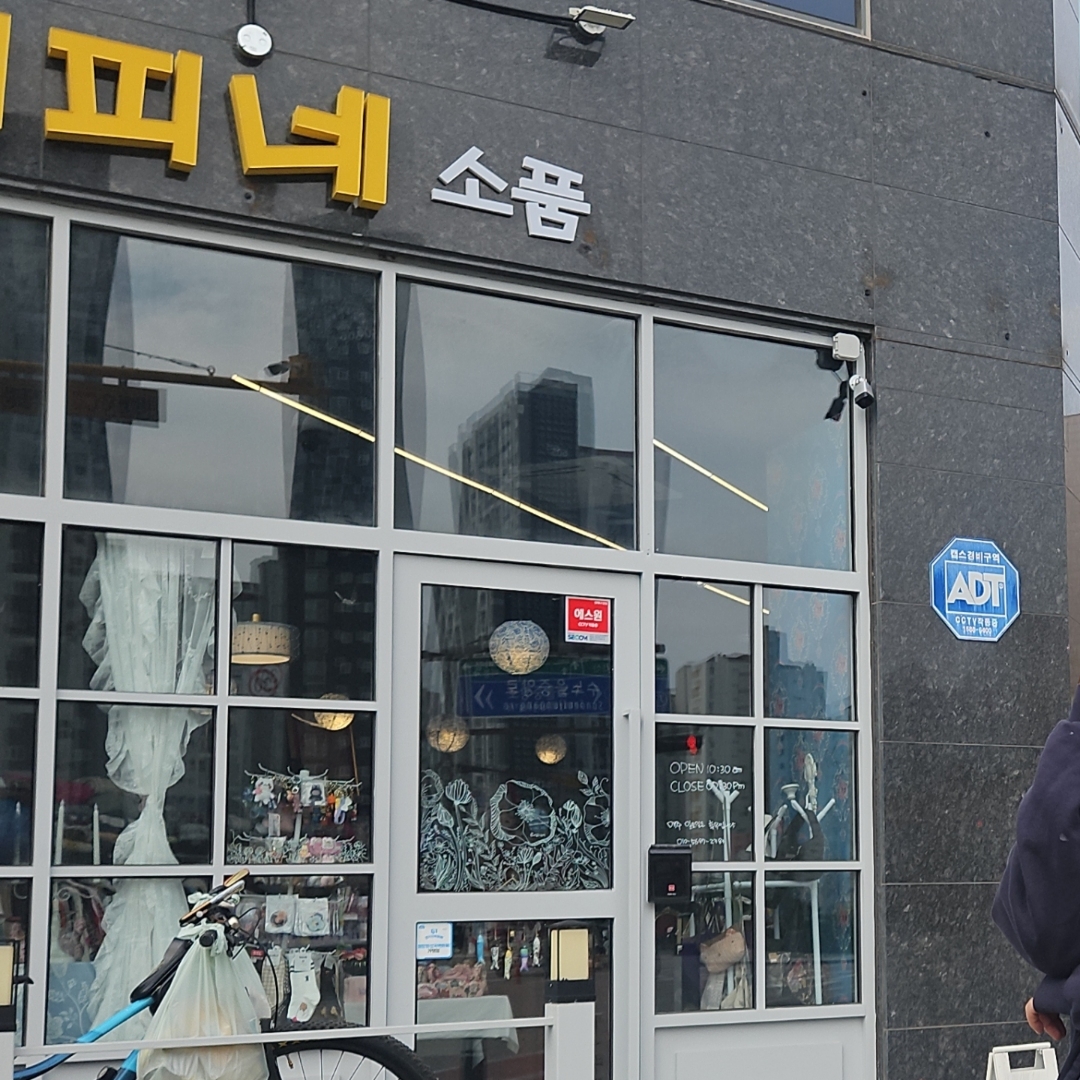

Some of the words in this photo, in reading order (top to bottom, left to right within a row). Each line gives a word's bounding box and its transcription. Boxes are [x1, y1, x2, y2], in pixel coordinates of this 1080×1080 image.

[0, 12, 391, 212] 피네
[431, 145, 591, 242] 소품
[947, 571, 1004, 608] ADT
[573, 608, 603, 622] 에스원
[669, 761, 705, 775] OPEN
[706, 764, 731, 775] 10:30
[669, 780, 705, 793] CLOSE
